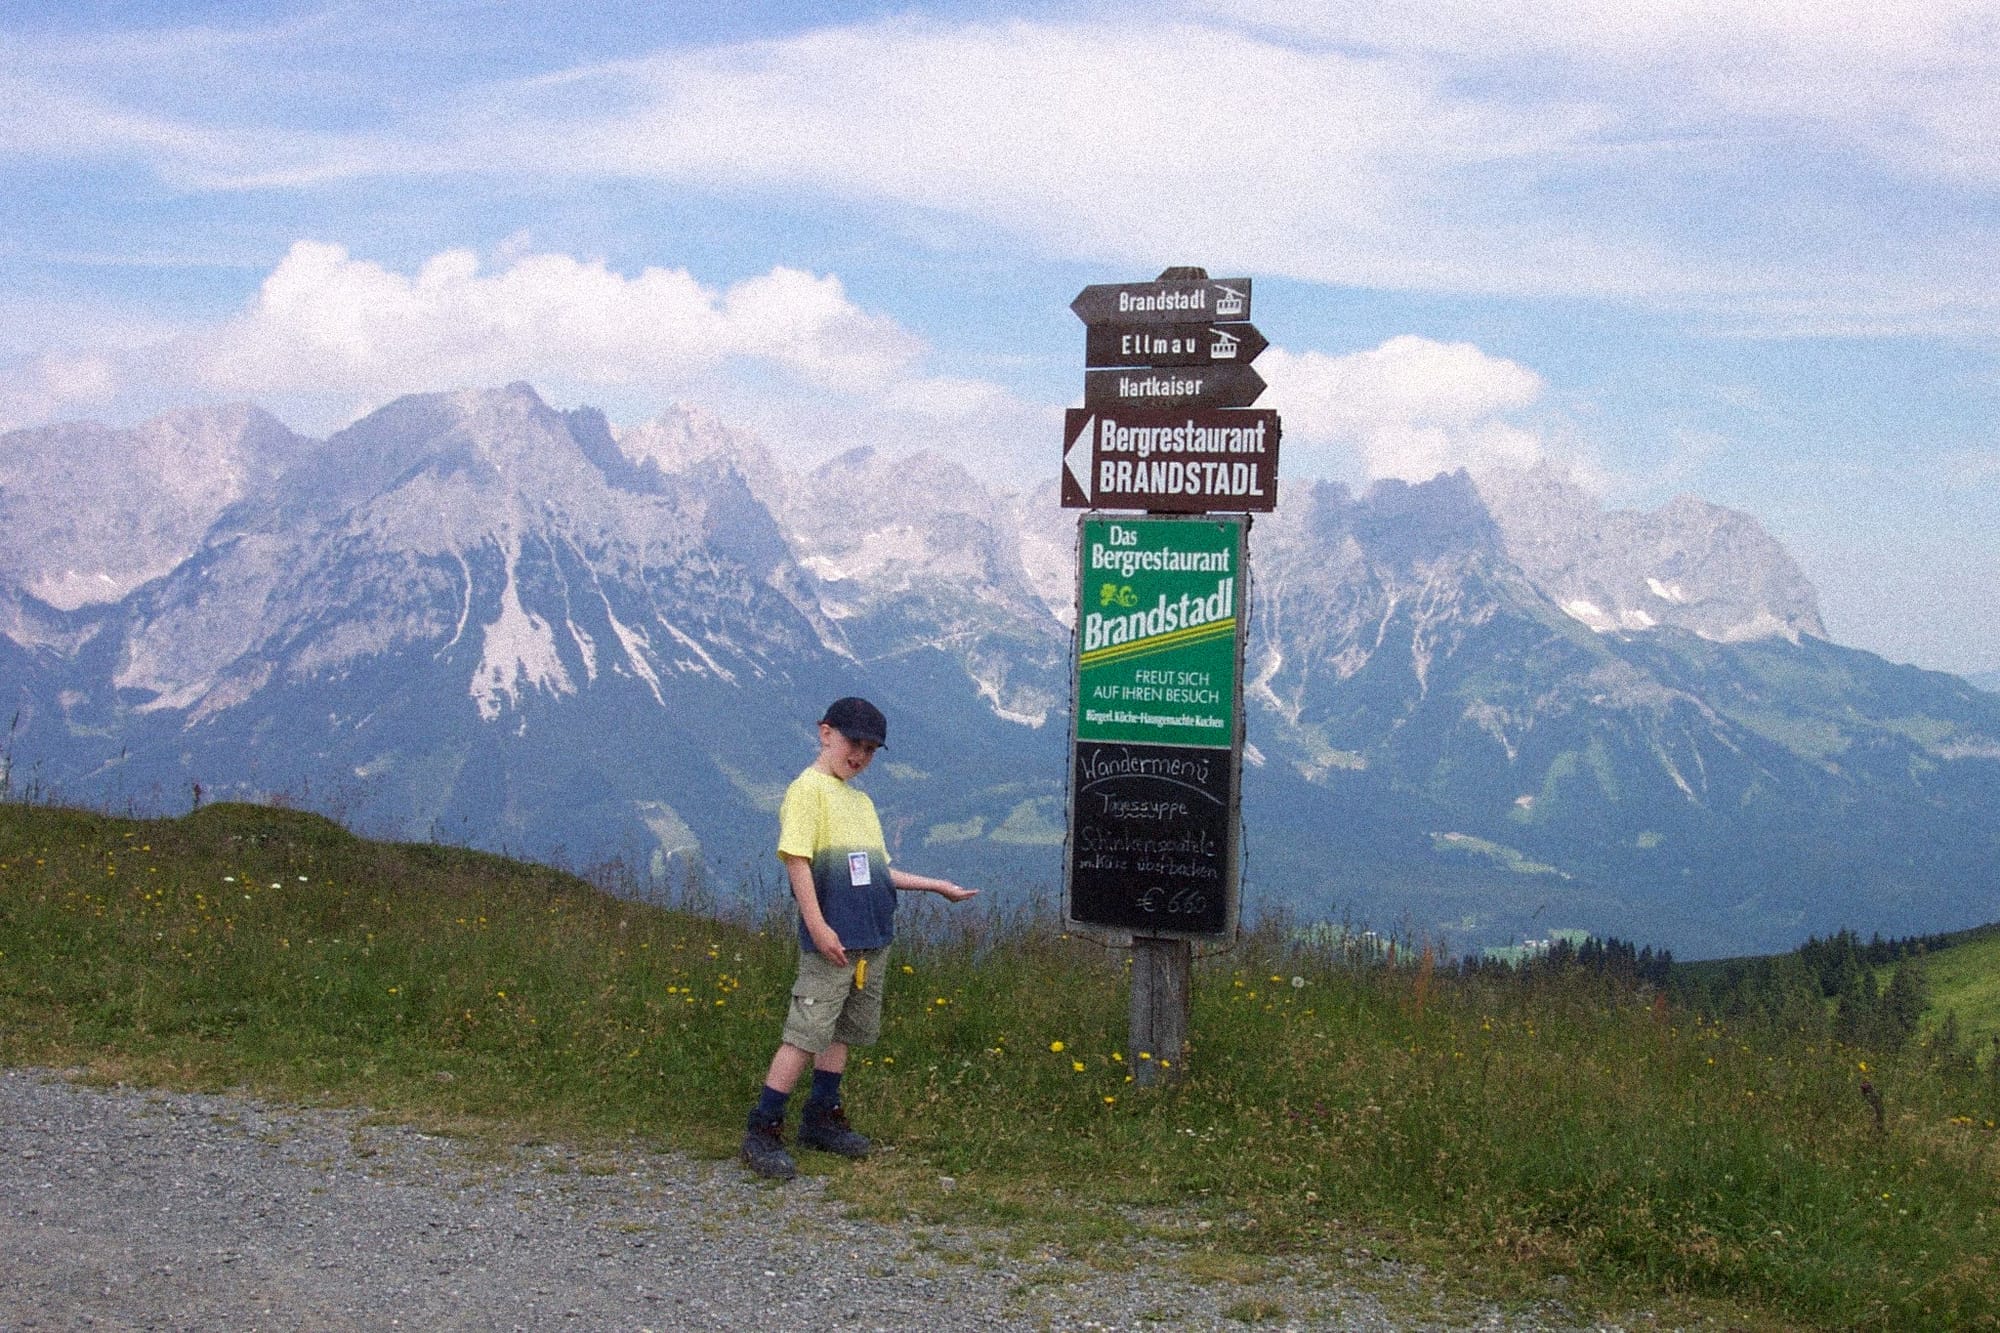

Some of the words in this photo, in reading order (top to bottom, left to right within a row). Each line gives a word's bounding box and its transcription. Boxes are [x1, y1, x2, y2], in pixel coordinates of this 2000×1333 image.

[1119, 289, 1205, 312] Brandstadl
[1121, 334, 1196, 355] Ellmau
[1119, 375, 1203, 397] Hartkaiser
[1101, 419, 1265, 457] Bergrestaurant
[1100, 460, 1264, 496] BRANDSTADL
[1110, 525, 1138, 546] Das
[1092, 543, 1230, 578] Bergrestaurant
[1085, 577, 1234, 651] Brandstadl
[1135, 669, 1175, 685] FREUT
[1177, 671, 1210, 687] SICH
[1093, 685, 1120, 700] AUF
[1122, 687, 1163, 701] IHREN
[1165, 689, 1220, 704] BESUCH
[1195, 715, 1225, 728] Kuchen
[1081, 747, 1210, 784] Wandermenü
[1095, 791, 1188, 820] Tagessuppe
